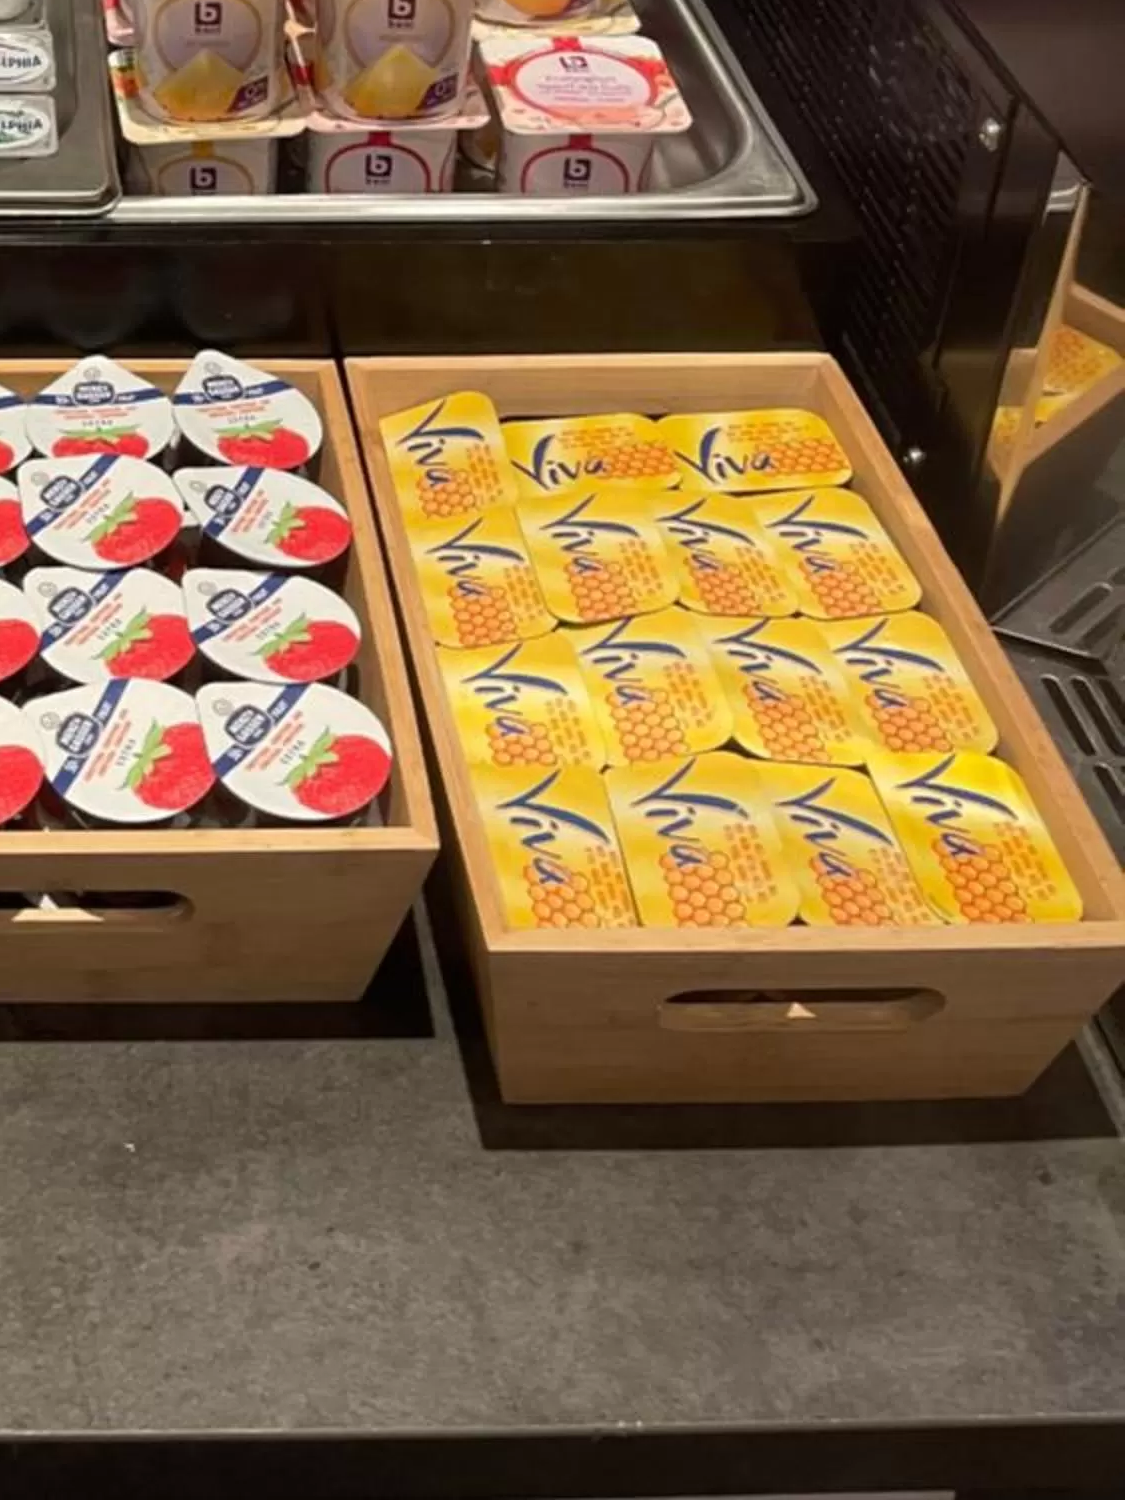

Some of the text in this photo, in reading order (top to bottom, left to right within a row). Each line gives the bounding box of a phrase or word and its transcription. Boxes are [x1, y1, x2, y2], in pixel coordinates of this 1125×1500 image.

[396, 400, 484, 487] Viva
[511, 433, 606, 491] Viva
[673, 427, 775, 484] Viva
[426, 518, 525, 597] Viva
[539, 494, 639, 574] Viva
[656, 498, 756, 571] Viva
[765, 496, 869, 573] Viva
[461, 642, 568, 736] Viva
[581, 617, 687, 705] Viva
[713, 617, 823, 701] Viva
[833, 618, 945, 708] Viva
[496, 769, 611, 884] Viva
[630, 758, 750, 868] Viva
[776, 777, 895, 878] Viva
[895, 754, 1019, 857] Viva
